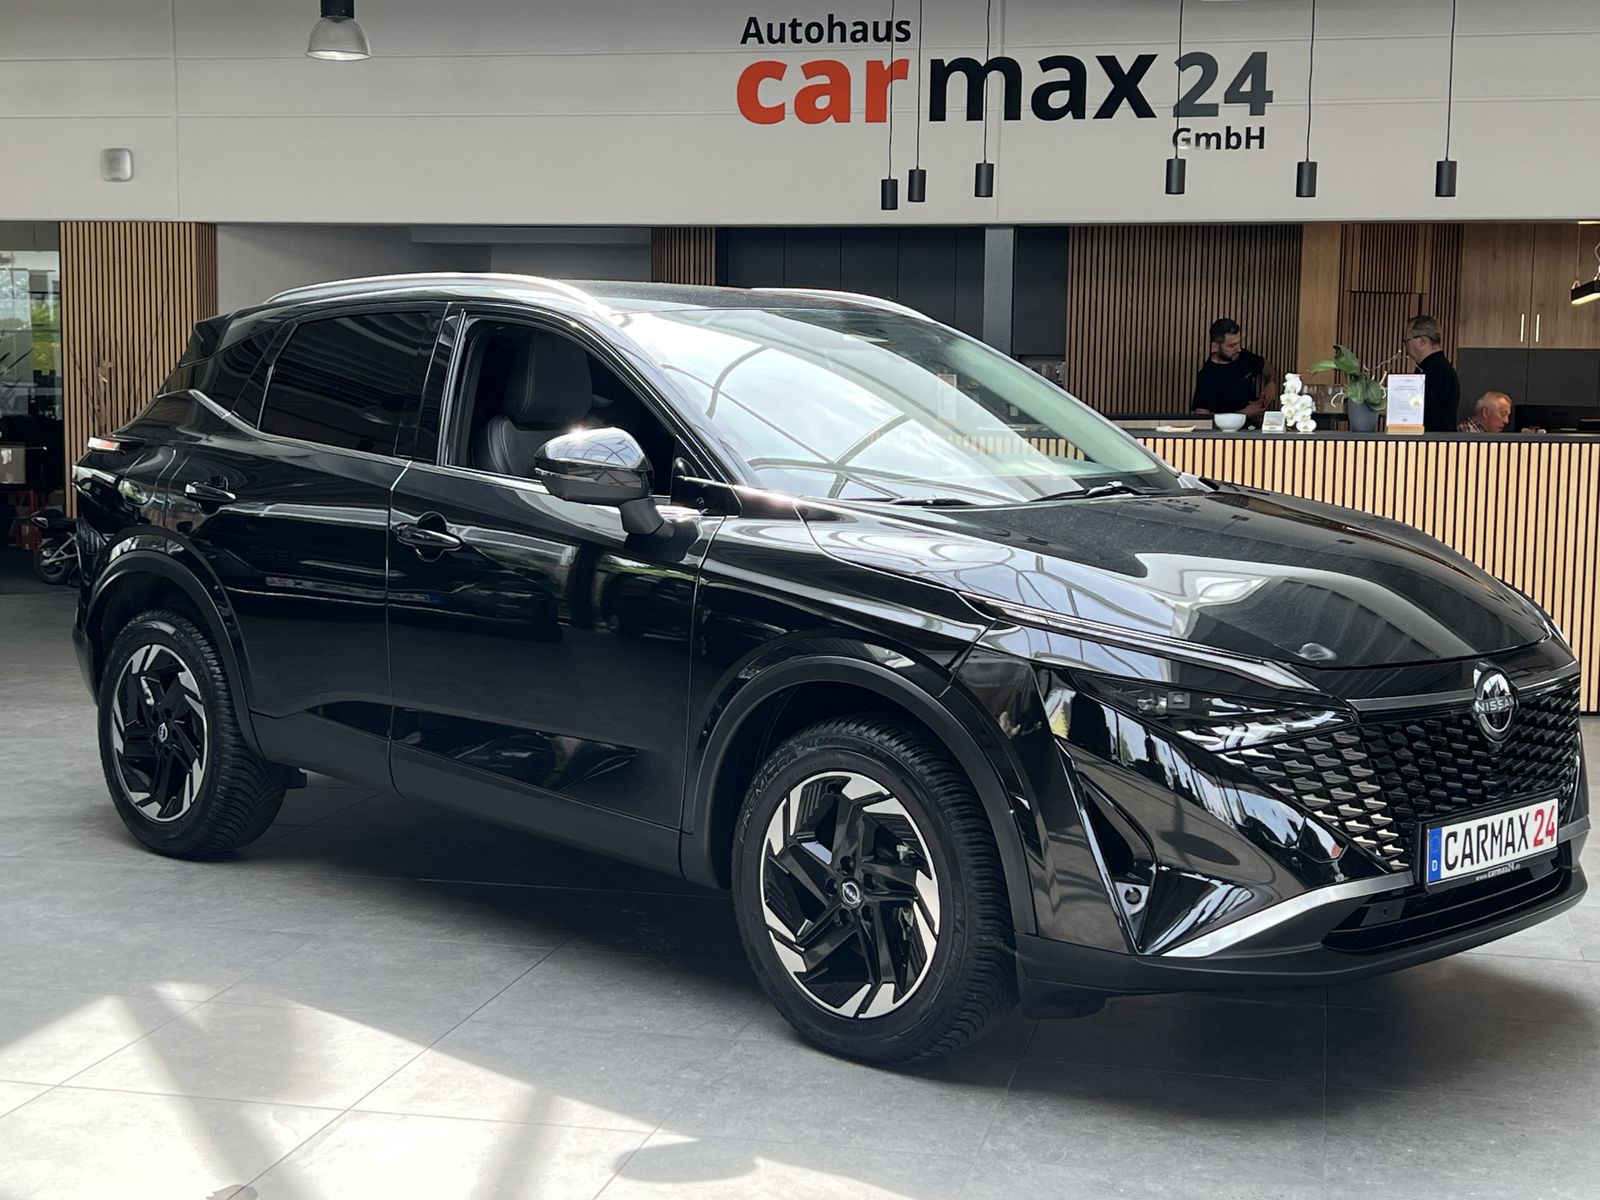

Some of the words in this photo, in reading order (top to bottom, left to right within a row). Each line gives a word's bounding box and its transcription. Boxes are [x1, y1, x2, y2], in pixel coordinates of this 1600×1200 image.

[740, 16, 912, 45] Autohaus
[1172, 125, 1266, 150] GmbH
[1474, 696, 1515, 714] NISSAN
